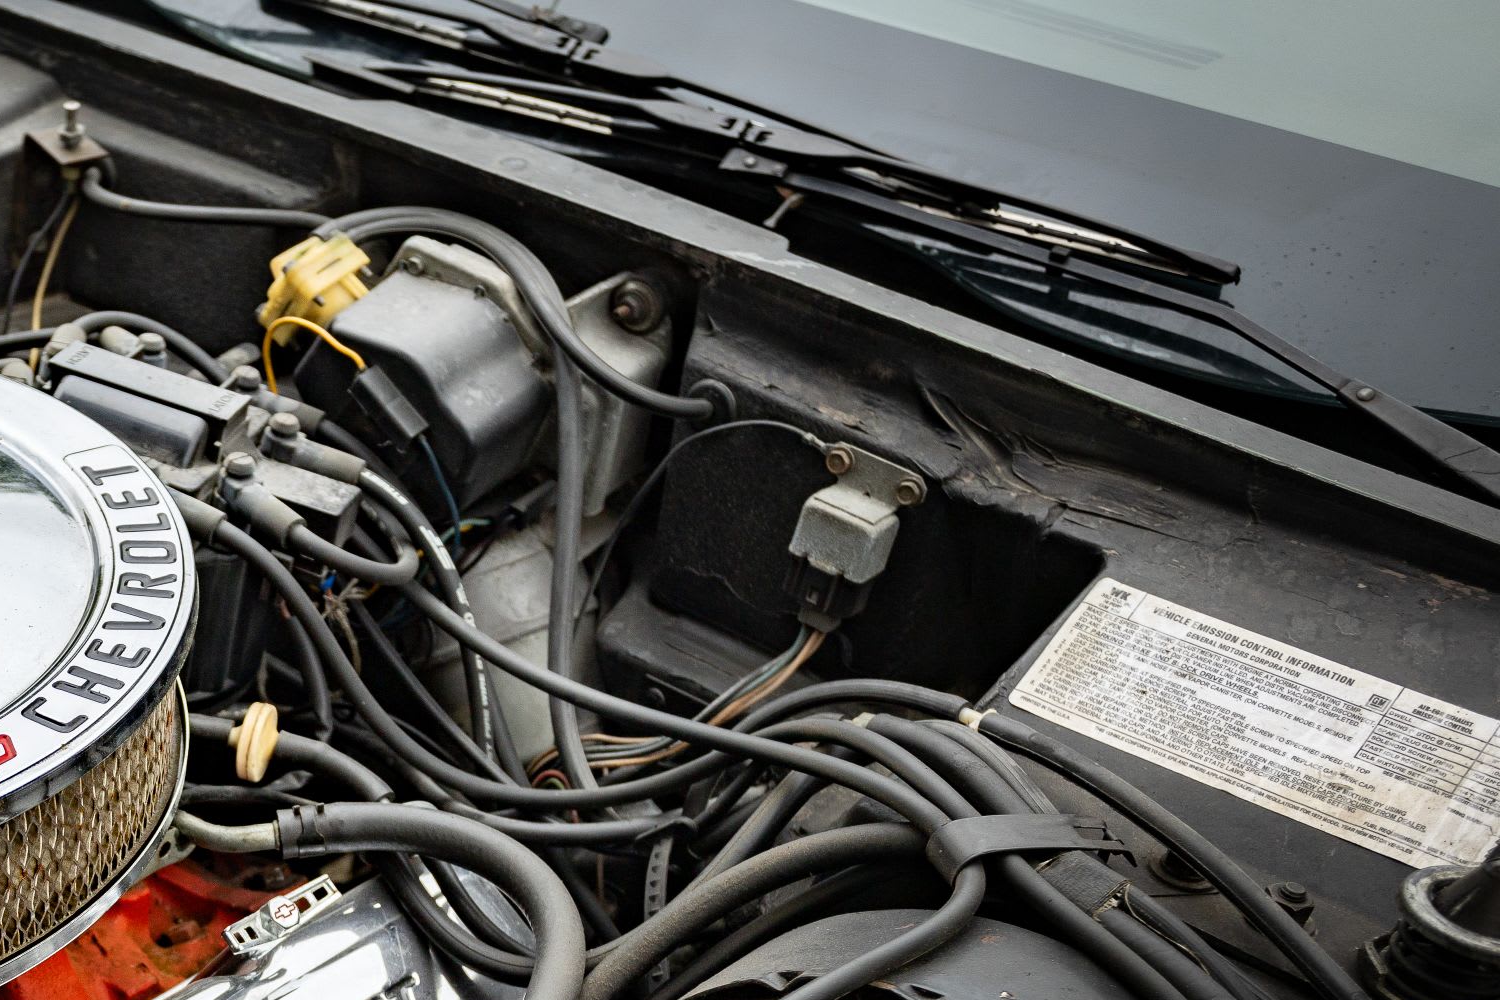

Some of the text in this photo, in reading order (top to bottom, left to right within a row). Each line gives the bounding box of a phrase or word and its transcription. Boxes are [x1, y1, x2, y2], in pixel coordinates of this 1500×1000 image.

[21, 464, 178, 733] CHEVROLET
[1089, 628, 1124, 644] PARKING
[1198, 670, 1225, 683] DRIVE
[1224, 680, 1260, 697] WHEELS.
[1151, 606, 1355, 686] VEHICLE EMISSION CONTROL INFORMATION
[1185, 631, 1301, 677] GENERAL MOTORS CORPORATION
[1163, 685, 1187, 697] SCREW
[1197, 698, 1231, 714] SPECIFIED
[1191, 660, 1219, 673] VACUUM
[1219, 670, 1234, 679] LINE
[1234, 676, 1255, 687] WHEN
[1254, 684, 1302, 705] ADJUSTMENTS
[1220, 657, 1239, 667] WITH
[1238, 664, 1264, 676] ENGINE
[1273, 677, 1302, 691] NORMAL
[1301, 688, 1341, 706] OPERATING
[1249, 675, 1264, 683] AND
[1285, 689, 1315, 703] VACUUM
[1314, 699, 1331, 709] LINE
[1371, 696, 1386, 706] GM
[1148, 693, 1202, 717] CONNECTED FOR
[1153, 701, 1176, 713] VAPOR
[1223, 728, 1259, 746] CORVETTE
[1167, 714, 1182, 723] NOT
[1182, 719, 1210, 733] REMOVE
[1187, 675, 1210, 687] VAPOR
[1256, 702, 1293, 719] CORVETTE
[1322, 727, 1353, 742] REMOVE
[1382, 719, 1408, 731] TIMING
[1127, 719, 1145, 729] CAPS
[1145, 727, 1160, 735] AND
[1159, 732, 1192, 748] ALTERING
[1202, 749, 1226, 762] OTHER
[1225, 758, 1245, 769] THAN
[1279, 779, 1296, 789] IDLE
[1295, 786, 1326, 801] MIXTURE
[1165, 741, 1180, 750] AND
[1179, 747, 1203, 759] OTHER
[1203, 756, 1225, 768] STATE
[1190, 702, 1216, 715] ADJUST
[1215, 712, 1234, 722] FAST
[1233, 719, 1249, 728] IDLE
[1249, 725, 1274, 738] SCREW
[1284, 739, 1318, 755] SPECIFIED
[1319, 753, 1343, 765] SPEED
[1354, 766, 1370, 775] TOP
[1364, 743, 1382, 753] FAST
[1406, 748, 1433, 761] SCREW
[1158, 717, 1187, 731] MIXTURE
[1187, 728, 1210, 741] SCREW
[1210, 738, 1229, 748] CAPS
[1229, 745, 1248, 756] HAVE
[1248, 753, 1267, 763] BEEN
[1302, 774, 1325, 786] RESET
[1373, 800, 1384, 808] BY
[1384, 804, 1407, 816] USING
[1195, 738, 1243, 760] REPLACEMENT
[1291, 776, 1316, 789] SCREW
[1316, 786, 1336, 797] CAPS
[1374, 808, 1396, 820] FROM
[1299, 807, 1311, 815] FOR
